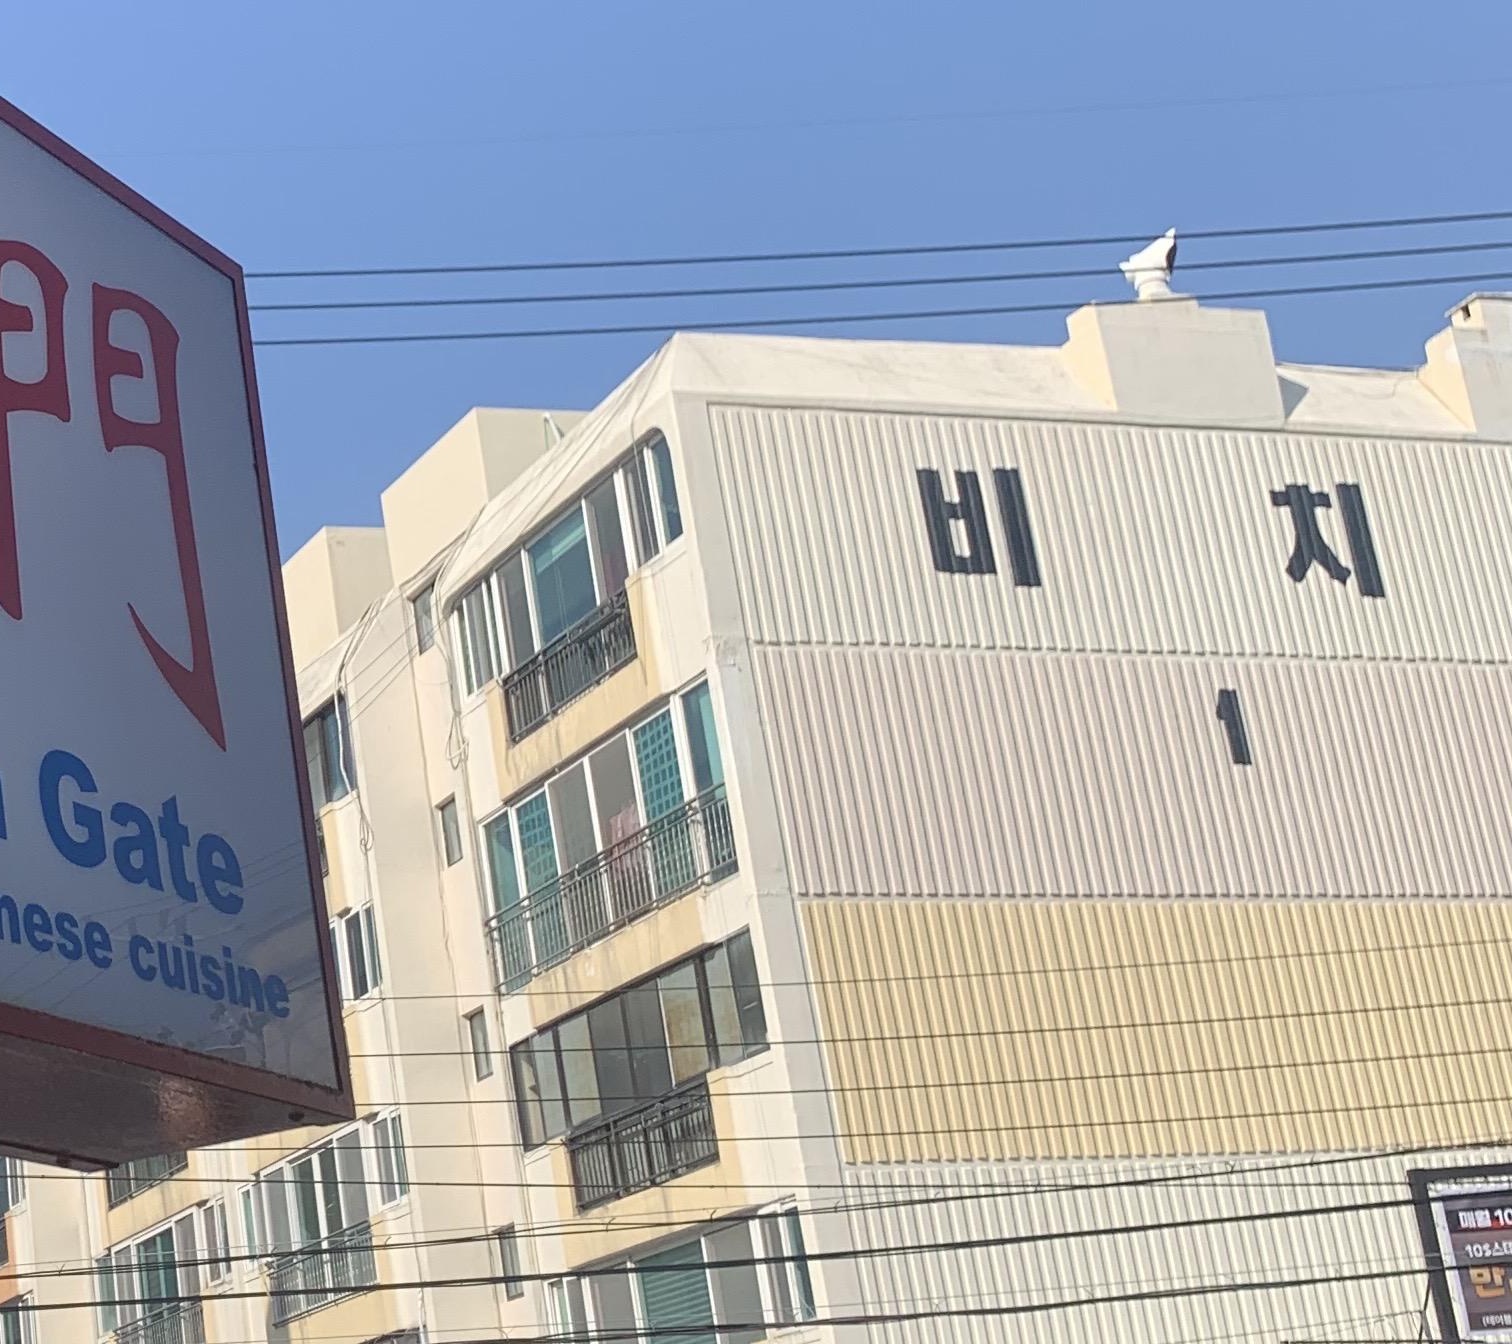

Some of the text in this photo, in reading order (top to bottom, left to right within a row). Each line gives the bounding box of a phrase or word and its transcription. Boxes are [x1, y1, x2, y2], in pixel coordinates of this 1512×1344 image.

[1215, 688, 1252, 766] 1
[38, 749, 244, 915] Gate
[129, 931, 289, 1019] cuisine
